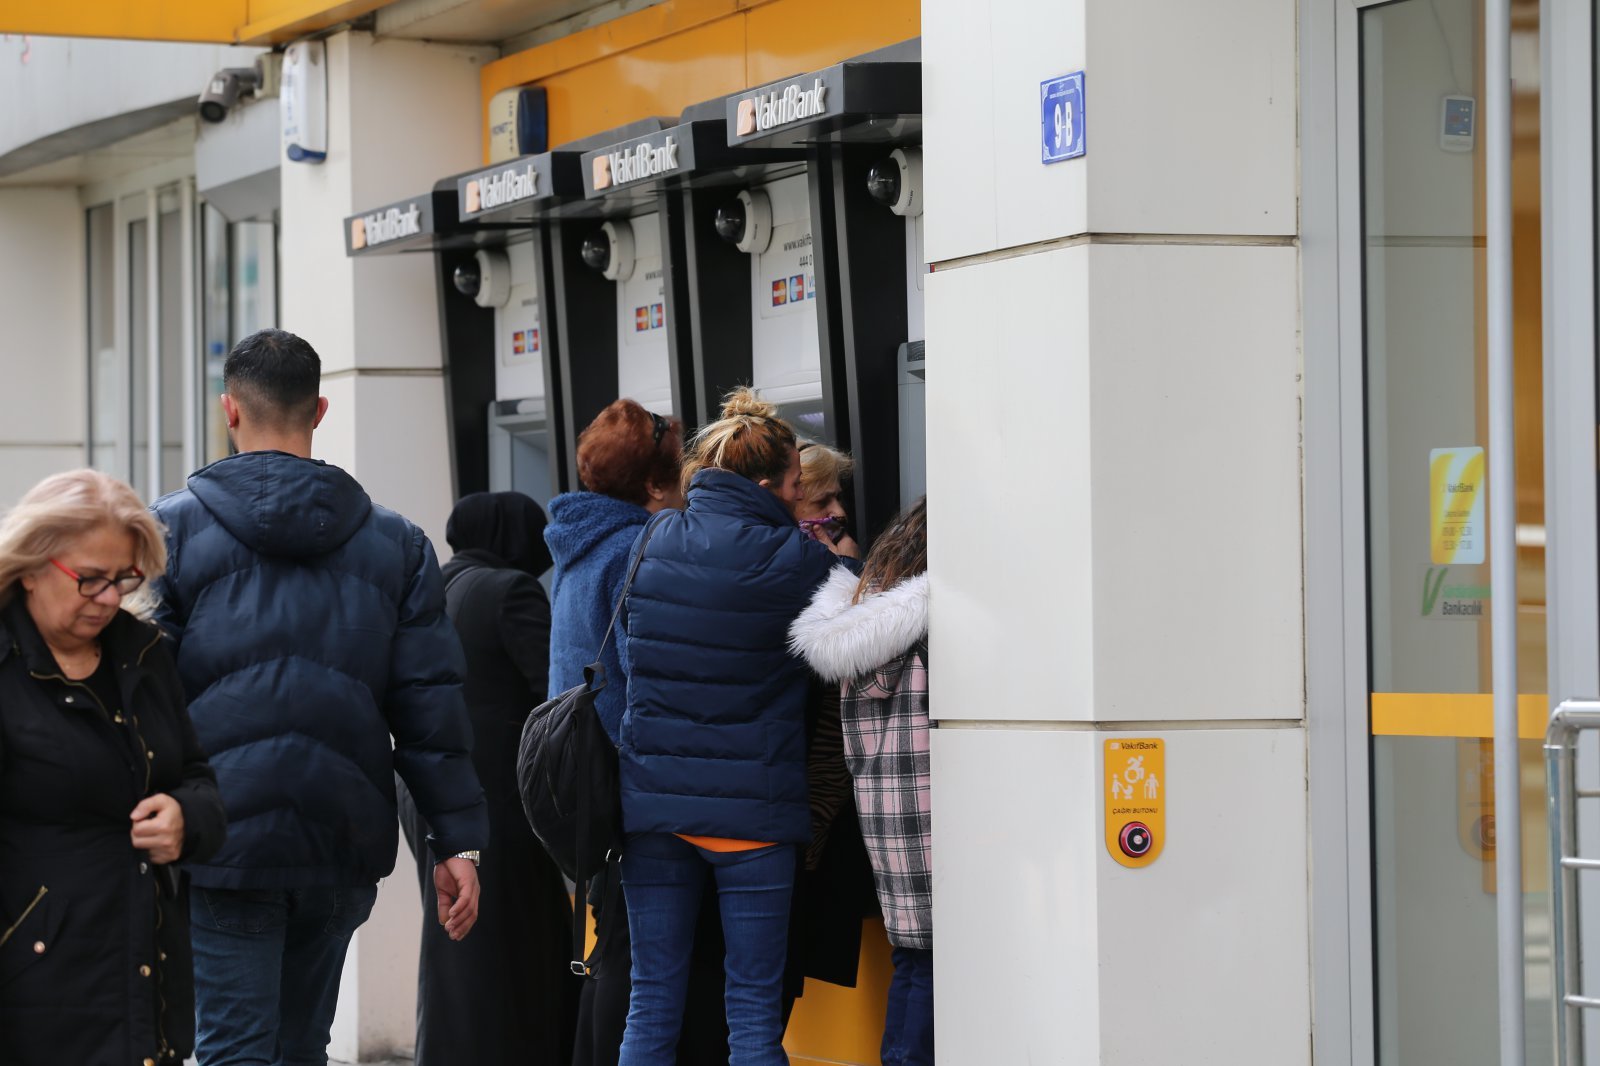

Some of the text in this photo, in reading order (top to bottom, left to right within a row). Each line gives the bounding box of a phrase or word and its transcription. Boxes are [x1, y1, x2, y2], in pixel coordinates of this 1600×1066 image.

[754, 78, 826, 132] VakıfBank
[608, 136, 679, 186] VakıfBank
[478, 164, 539, 210] VakıfBank
[363, 203, 421, 246] VakıfBank
[1120, 742, 1158, 750] VakıfBank
[1112, 807, 1132, 815] ÇAĞRI
